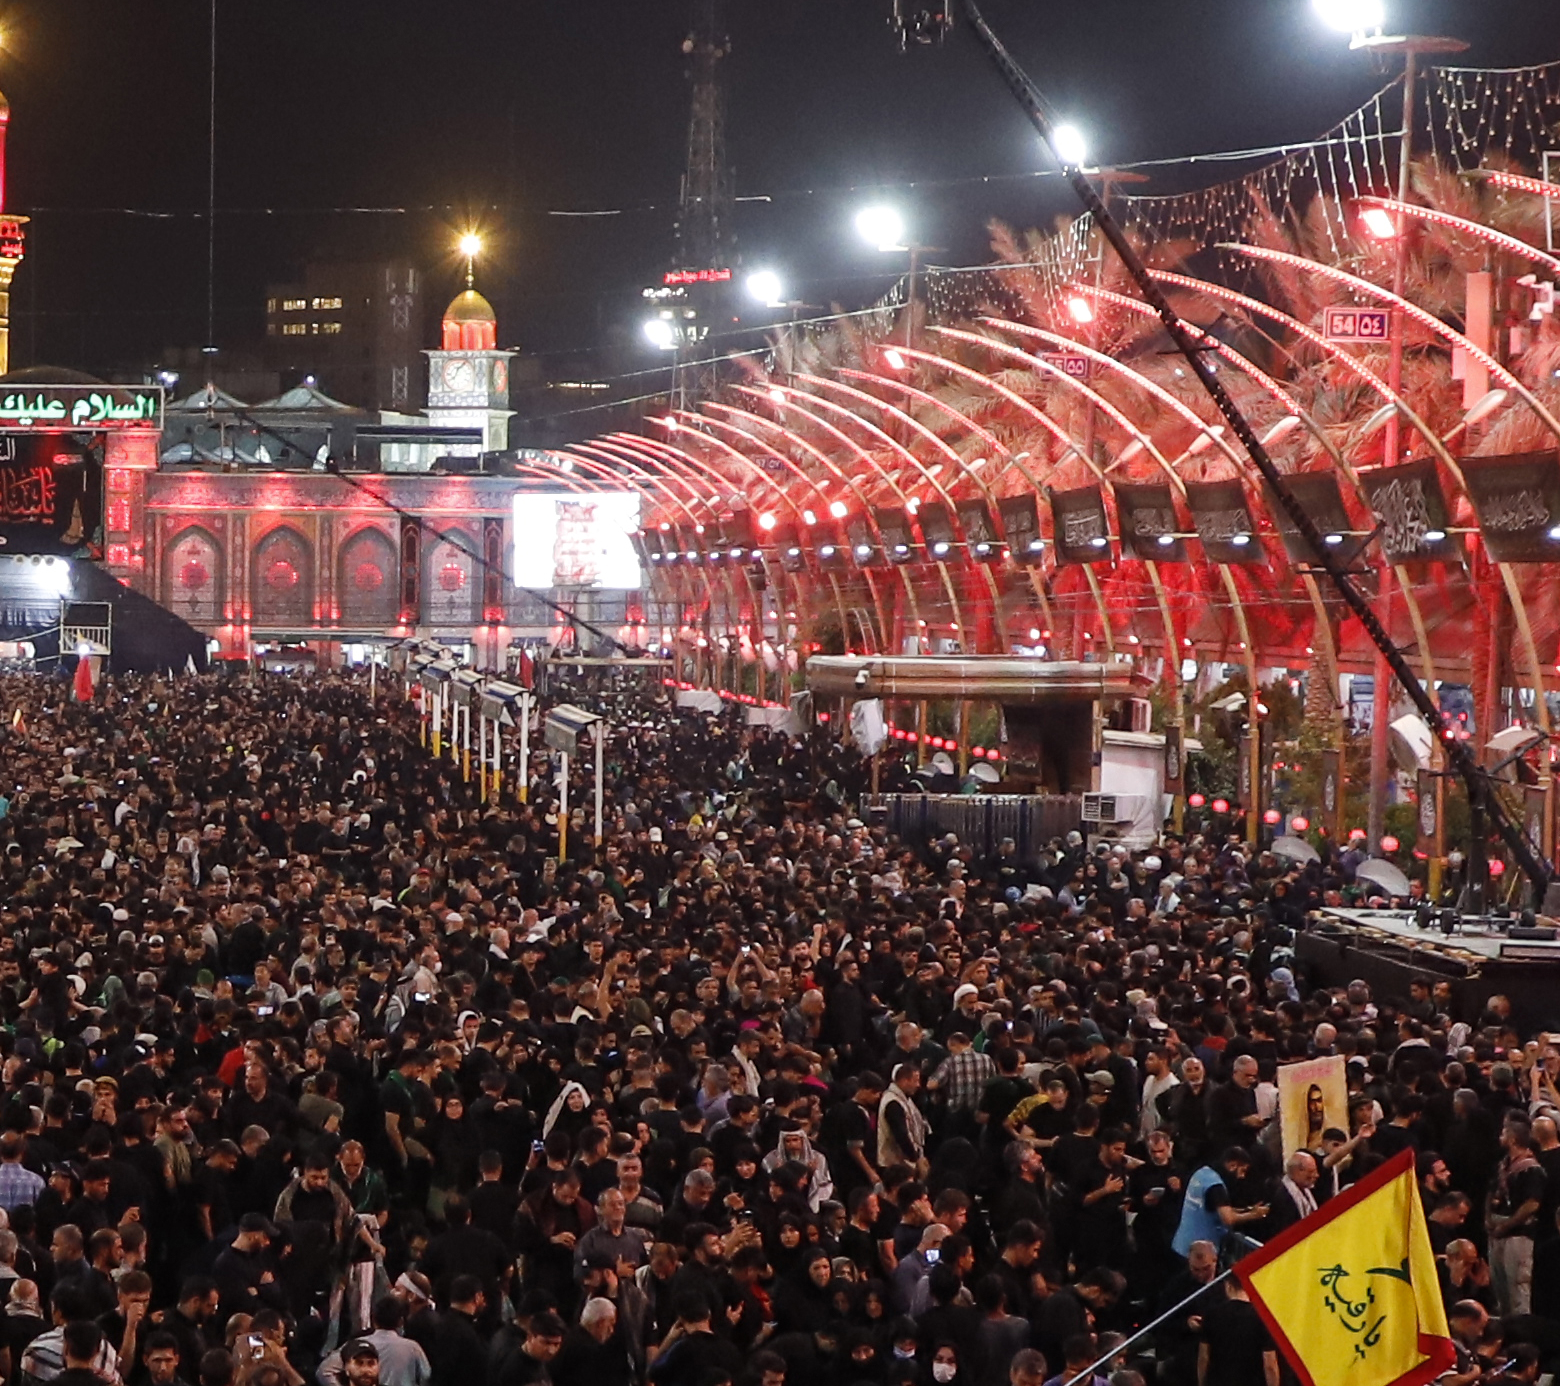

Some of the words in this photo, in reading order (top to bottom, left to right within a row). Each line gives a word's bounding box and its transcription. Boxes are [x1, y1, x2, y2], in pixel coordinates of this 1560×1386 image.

[1332, 315, 1355, 334] 54
[1360, 316, 1382, 336] ٥٤
[1067, 359, 1085, 375] ٥٥
[72, 394, 155, 425] السلام
